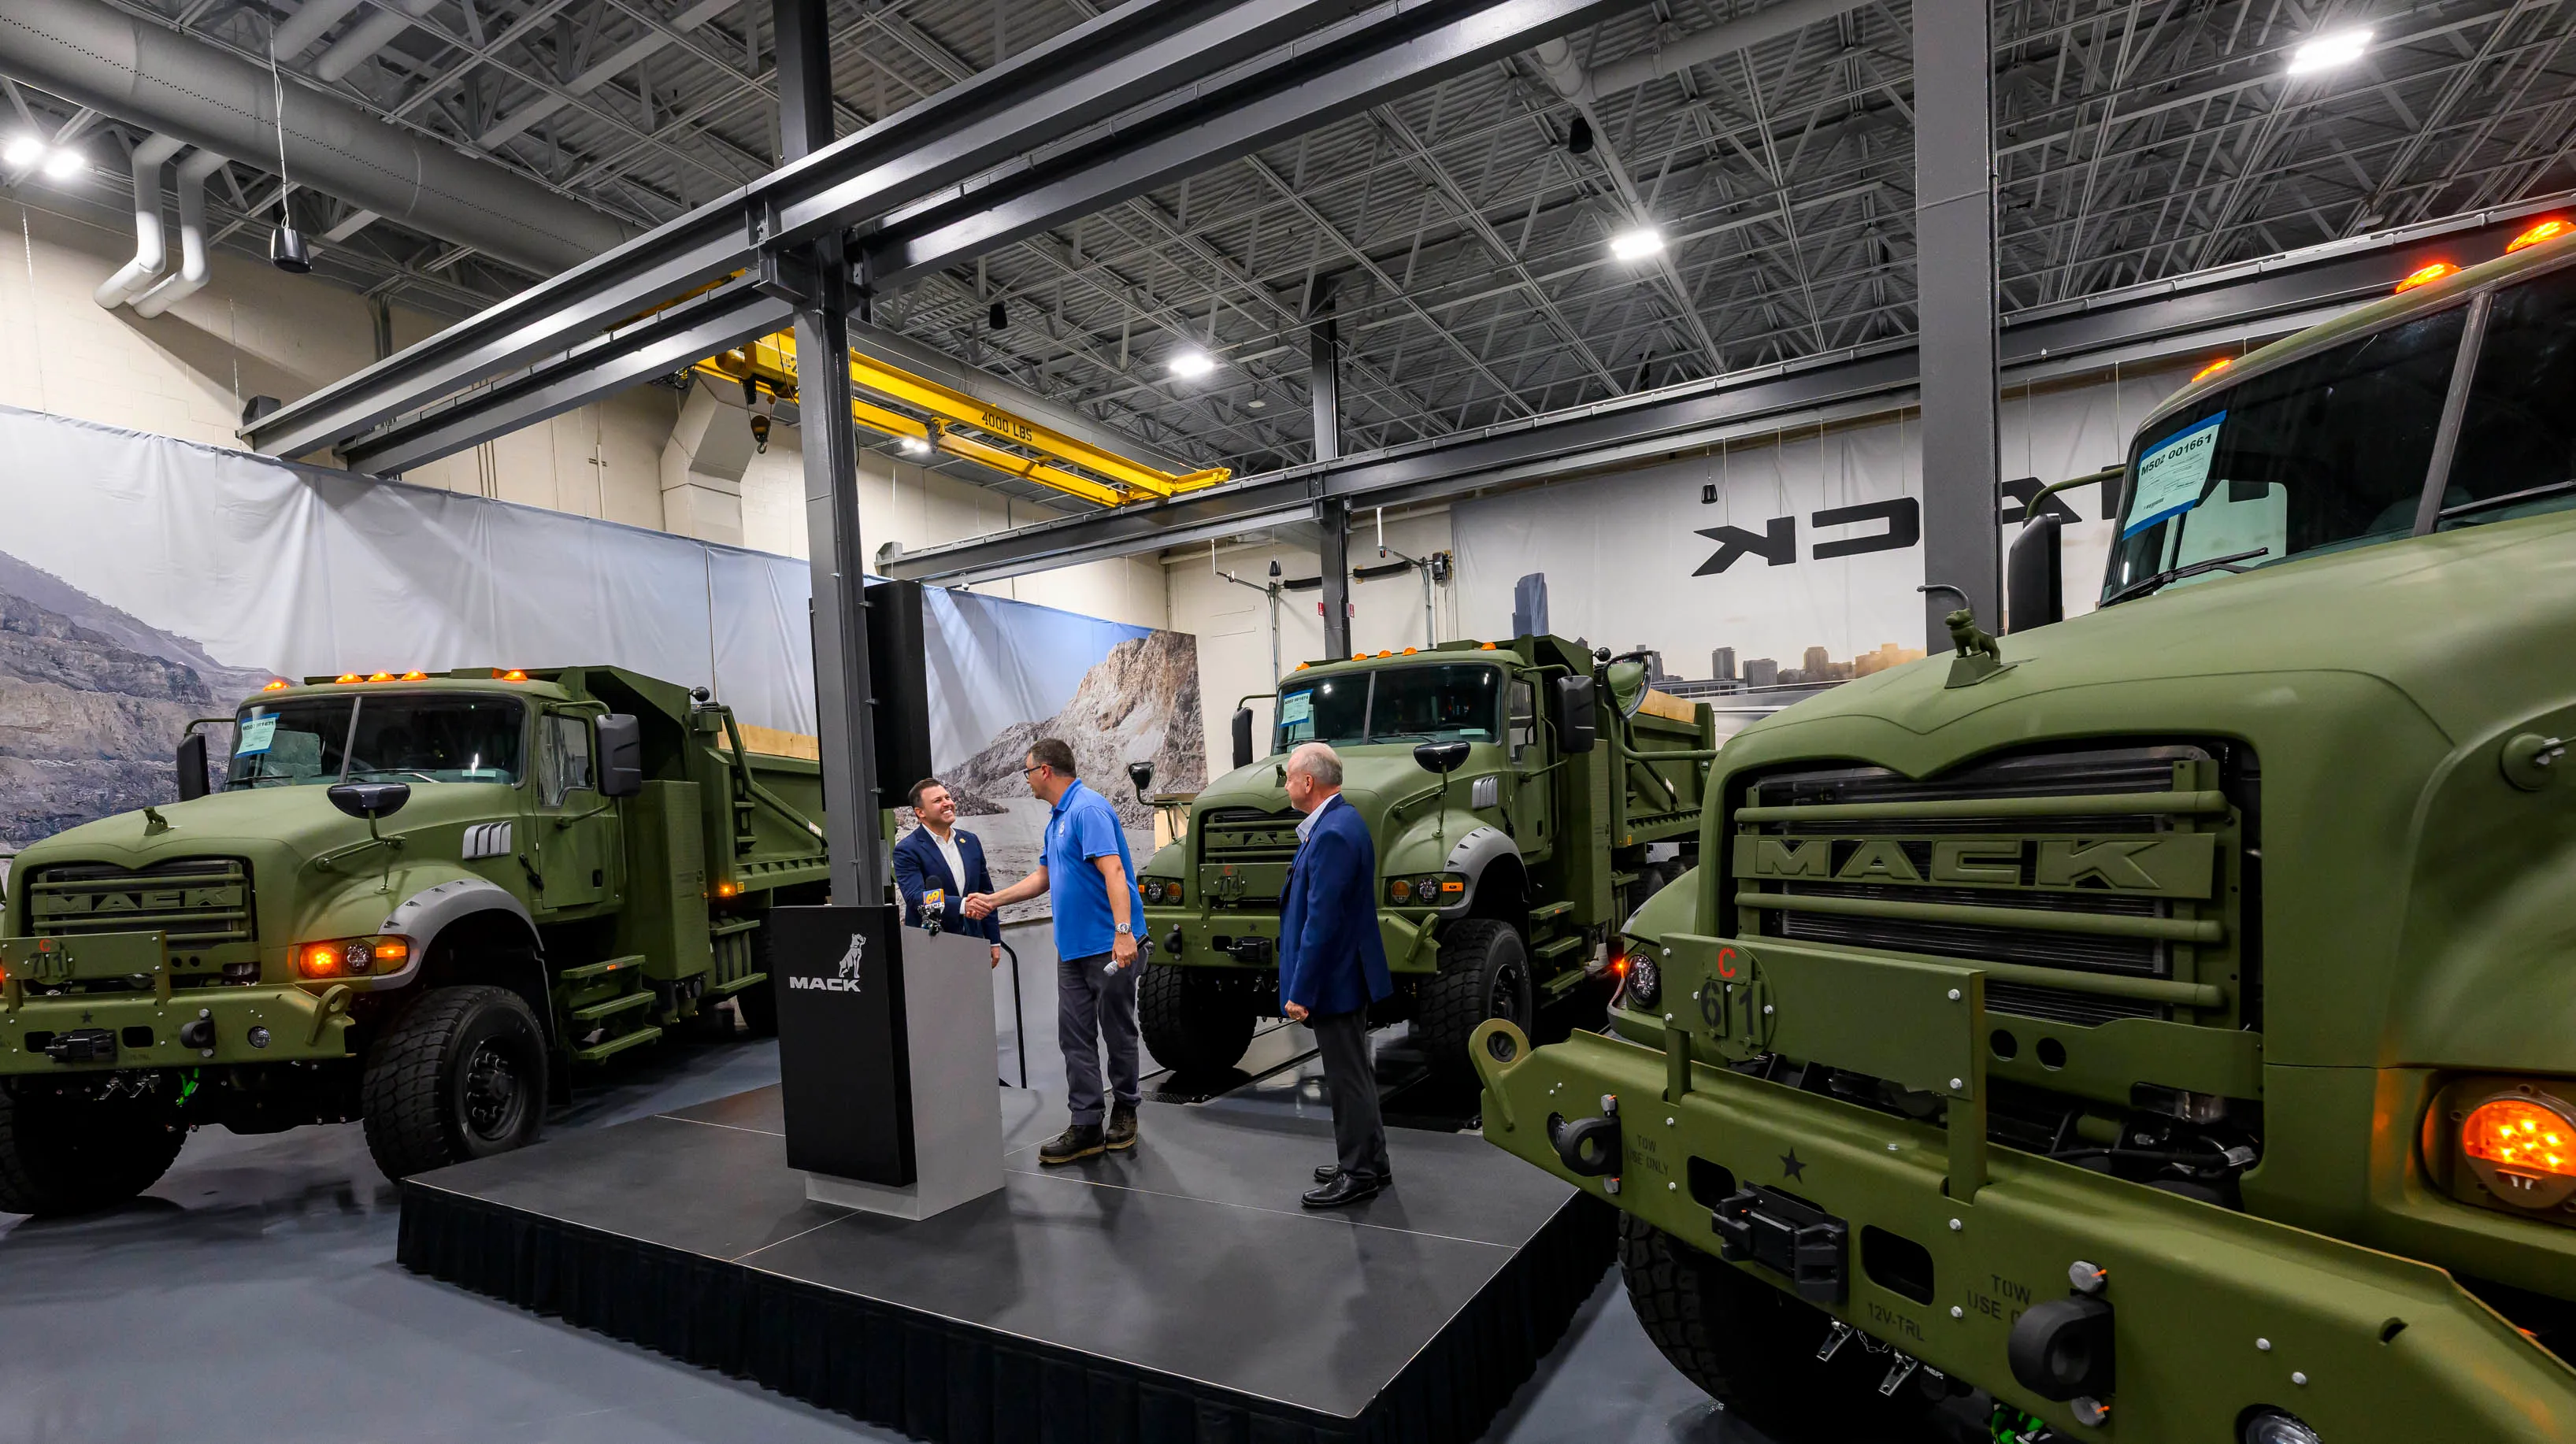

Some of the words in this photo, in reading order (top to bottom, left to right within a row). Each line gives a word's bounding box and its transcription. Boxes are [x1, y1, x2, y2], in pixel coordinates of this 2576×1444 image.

[981, 412, 1009, 433] 4000
[1013, 423, 1032, 442] LBS
[2140, 454, 2166, 476] M502
[2168, 434, 2212, 460] 001661
[1214, 831, 1299, 847] MAC
[1755, 839, 2163, 890] MACK
[46, 888, 229, 913] MACK
[925, 890, 940, 905] 69
[39, 939, 51, 952] C
[1718, 947, 1736, 978] C
[789, 976, 861, 992] MACK
[1701, 981, 1755, 1036] 61
[1637, 1134, 1657, 1153] TOW
[1646, 1155, 1669, 1176] ONLY
[1991, 1274, 2032, 1305] TOW
[1967, 1290, 2003, 1320] USE
[1867, 1302, 1926, 1342] 12V-TRL
